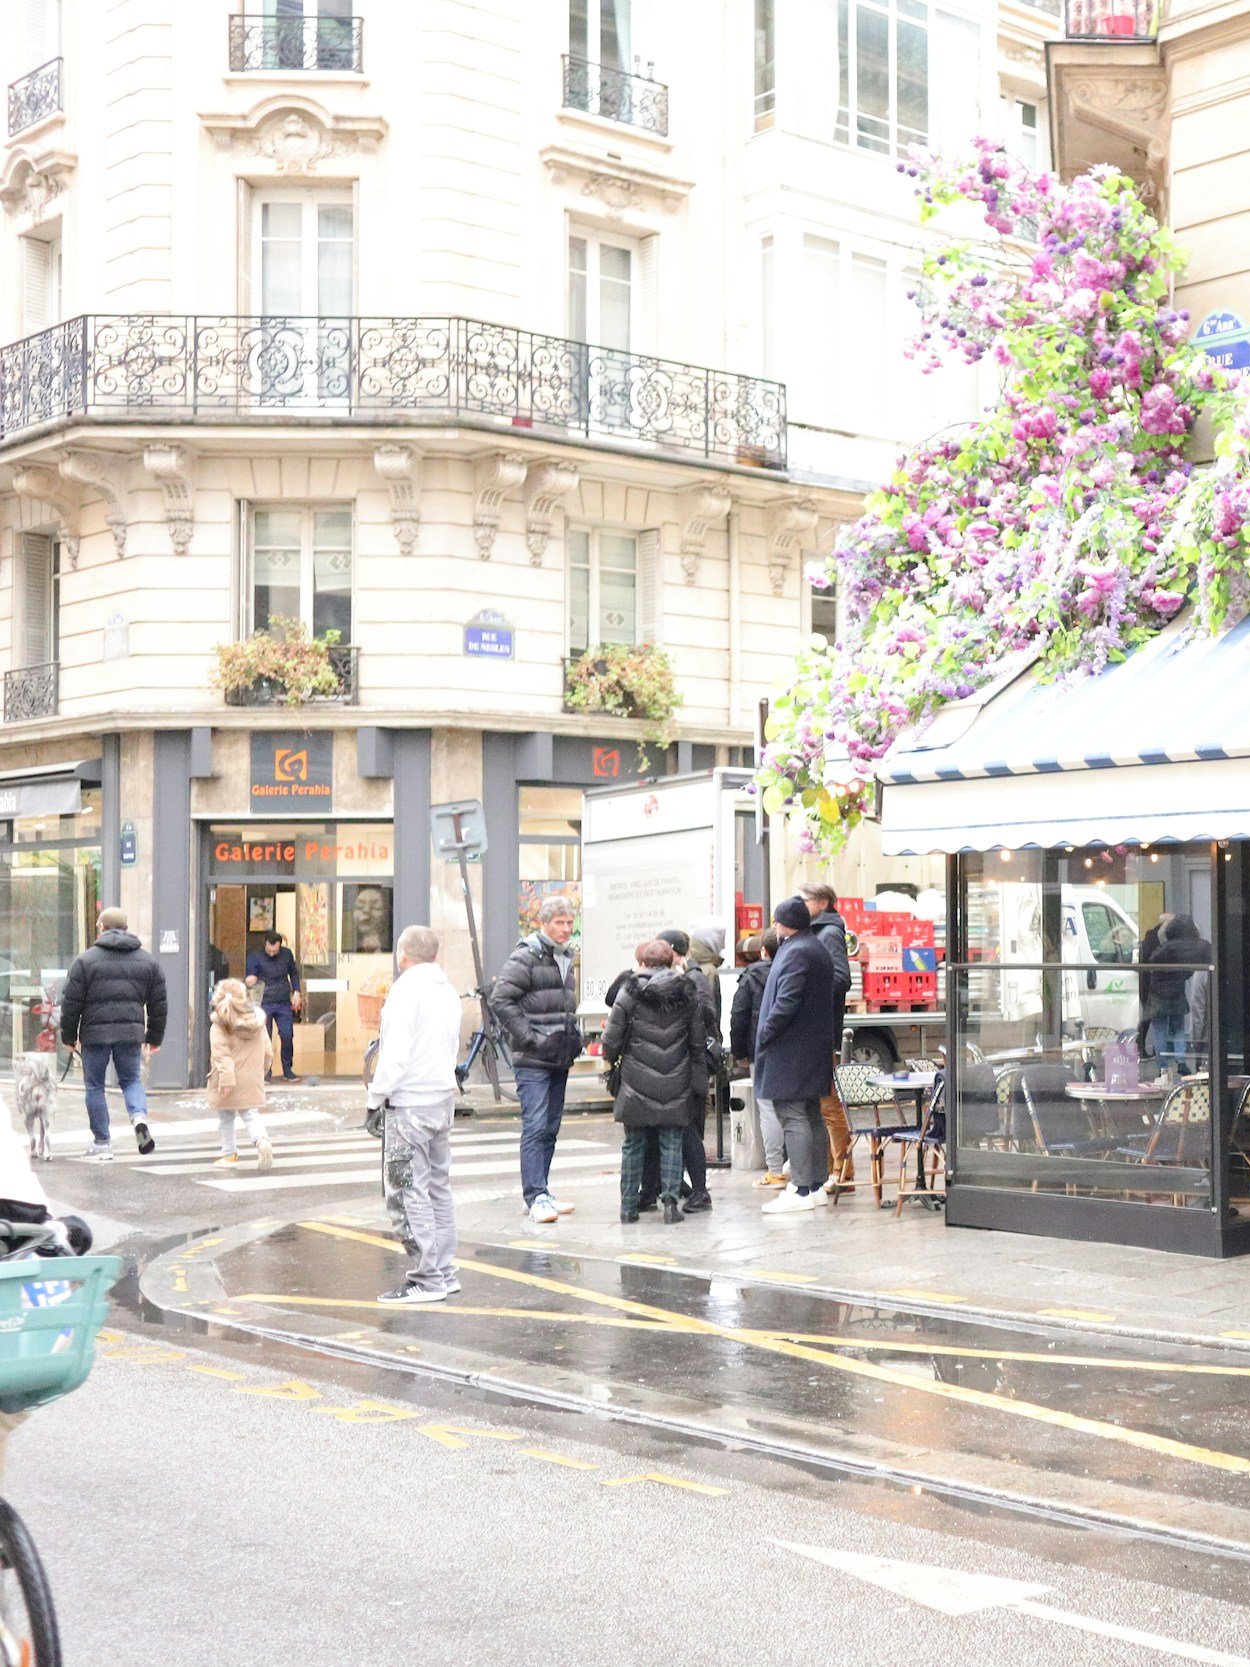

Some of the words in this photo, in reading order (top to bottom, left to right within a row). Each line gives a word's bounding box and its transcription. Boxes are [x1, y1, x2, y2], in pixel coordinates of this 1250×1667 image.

[251, 784, 289, 796] Galerie
[291, 783, 331, 796] Perahia
[215, 842, 296, 862] Galerie
[305, 840, 389, 861] Perahia
